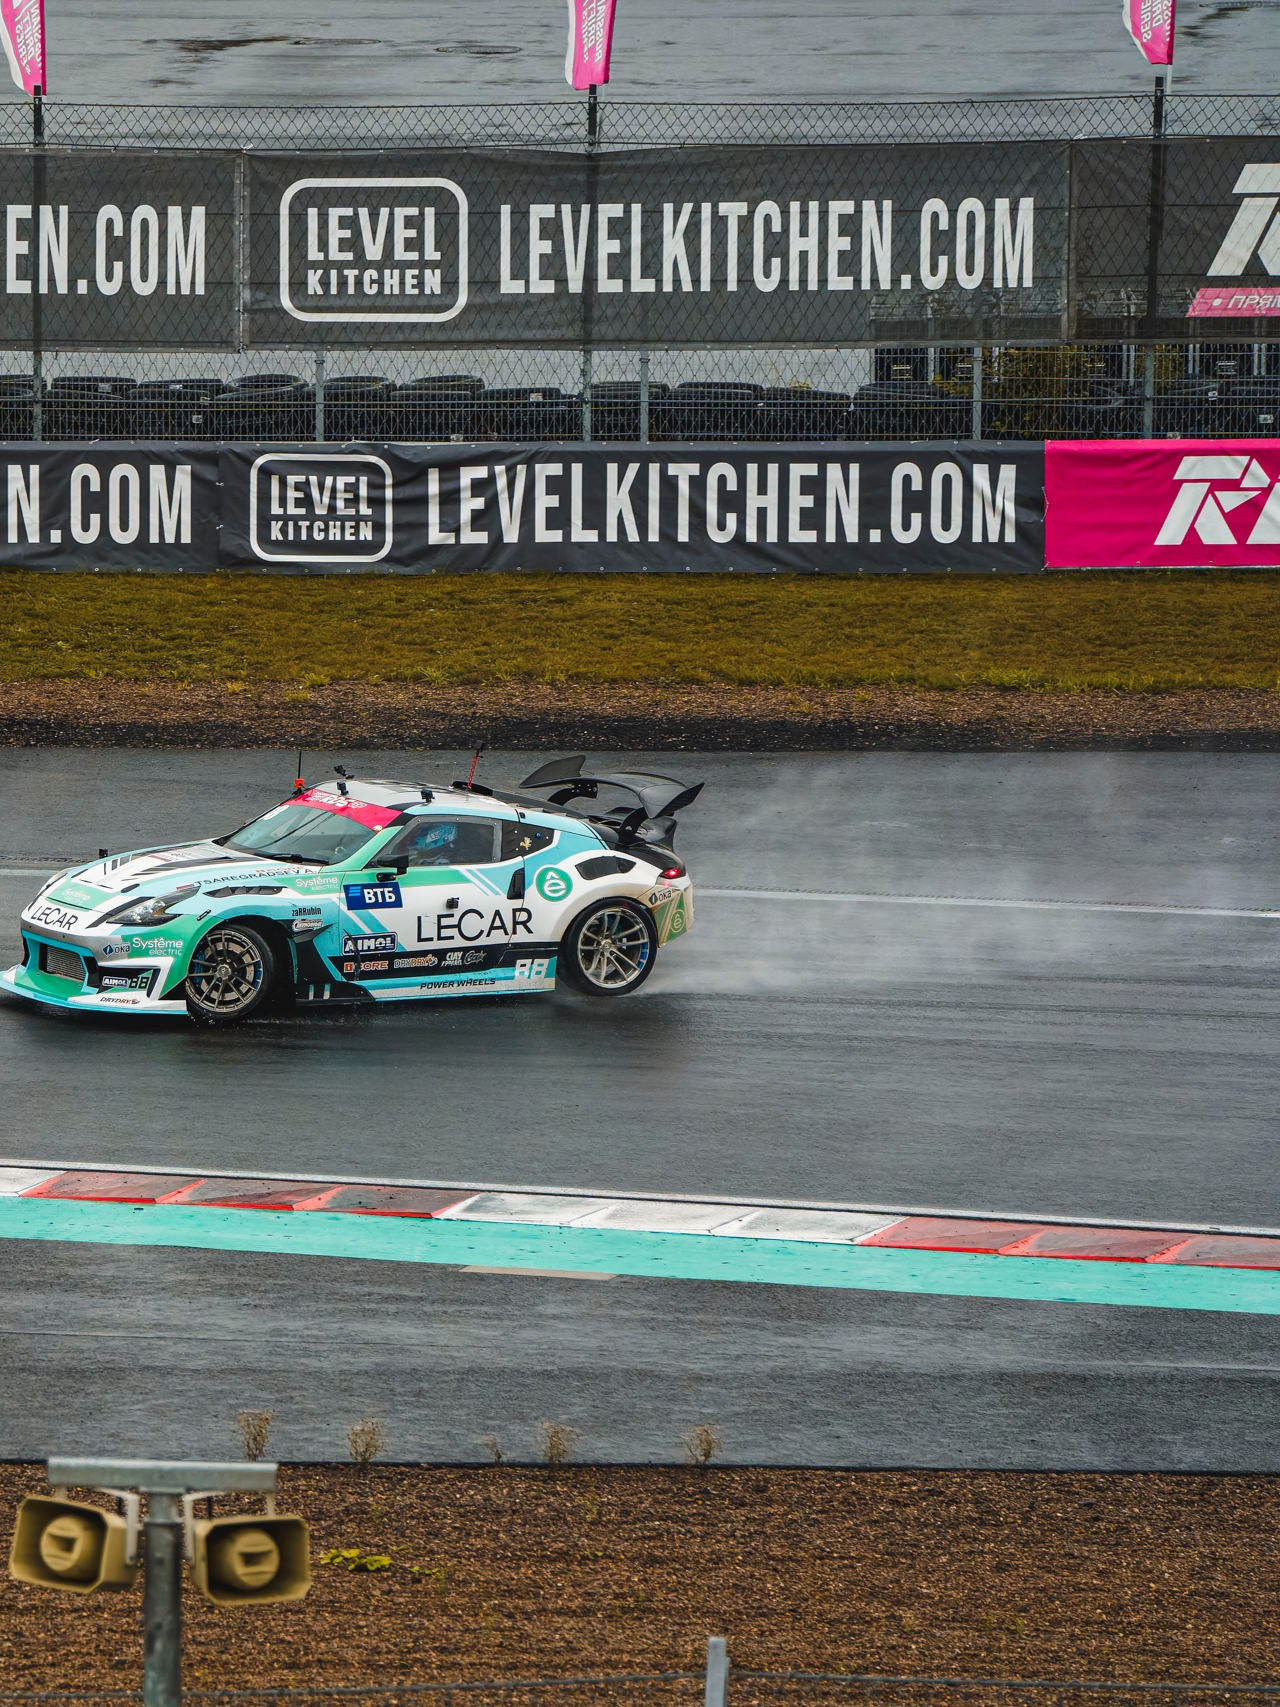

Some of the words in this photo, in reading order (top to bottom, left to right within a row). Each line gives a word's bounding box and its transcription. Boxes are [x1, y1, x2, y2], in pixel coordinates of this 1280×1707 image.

[307, 207, 442, 261] LEVEL
[499, 197, 1035, 294] LEVELKITCHEN.COM
[307, 268, 442, 296] KITCHEN
[270, 475, 373, 516] LEVEL
[427, 462, 1017, 545] LEVELKITCHEN.COM
[270, 520, 373, 542] KITCHEN
[363, 887, 397, 905] ВТБ
[30, 906, 79, 931] LECAR
[417, 908, 534, 943] LECAR
[132, 938, 184, 950] Système
[148, 948, 182, 956] electric
[345, 938, 395, 952] AIMOL
[514, 958, 550, 980] 88
[104, 978, 126, 986] AIMOL
[128, 976, 150, 989] 88
[420, 981, 455, 990] POWER
[457, 978, 496, 987] WHEELS
